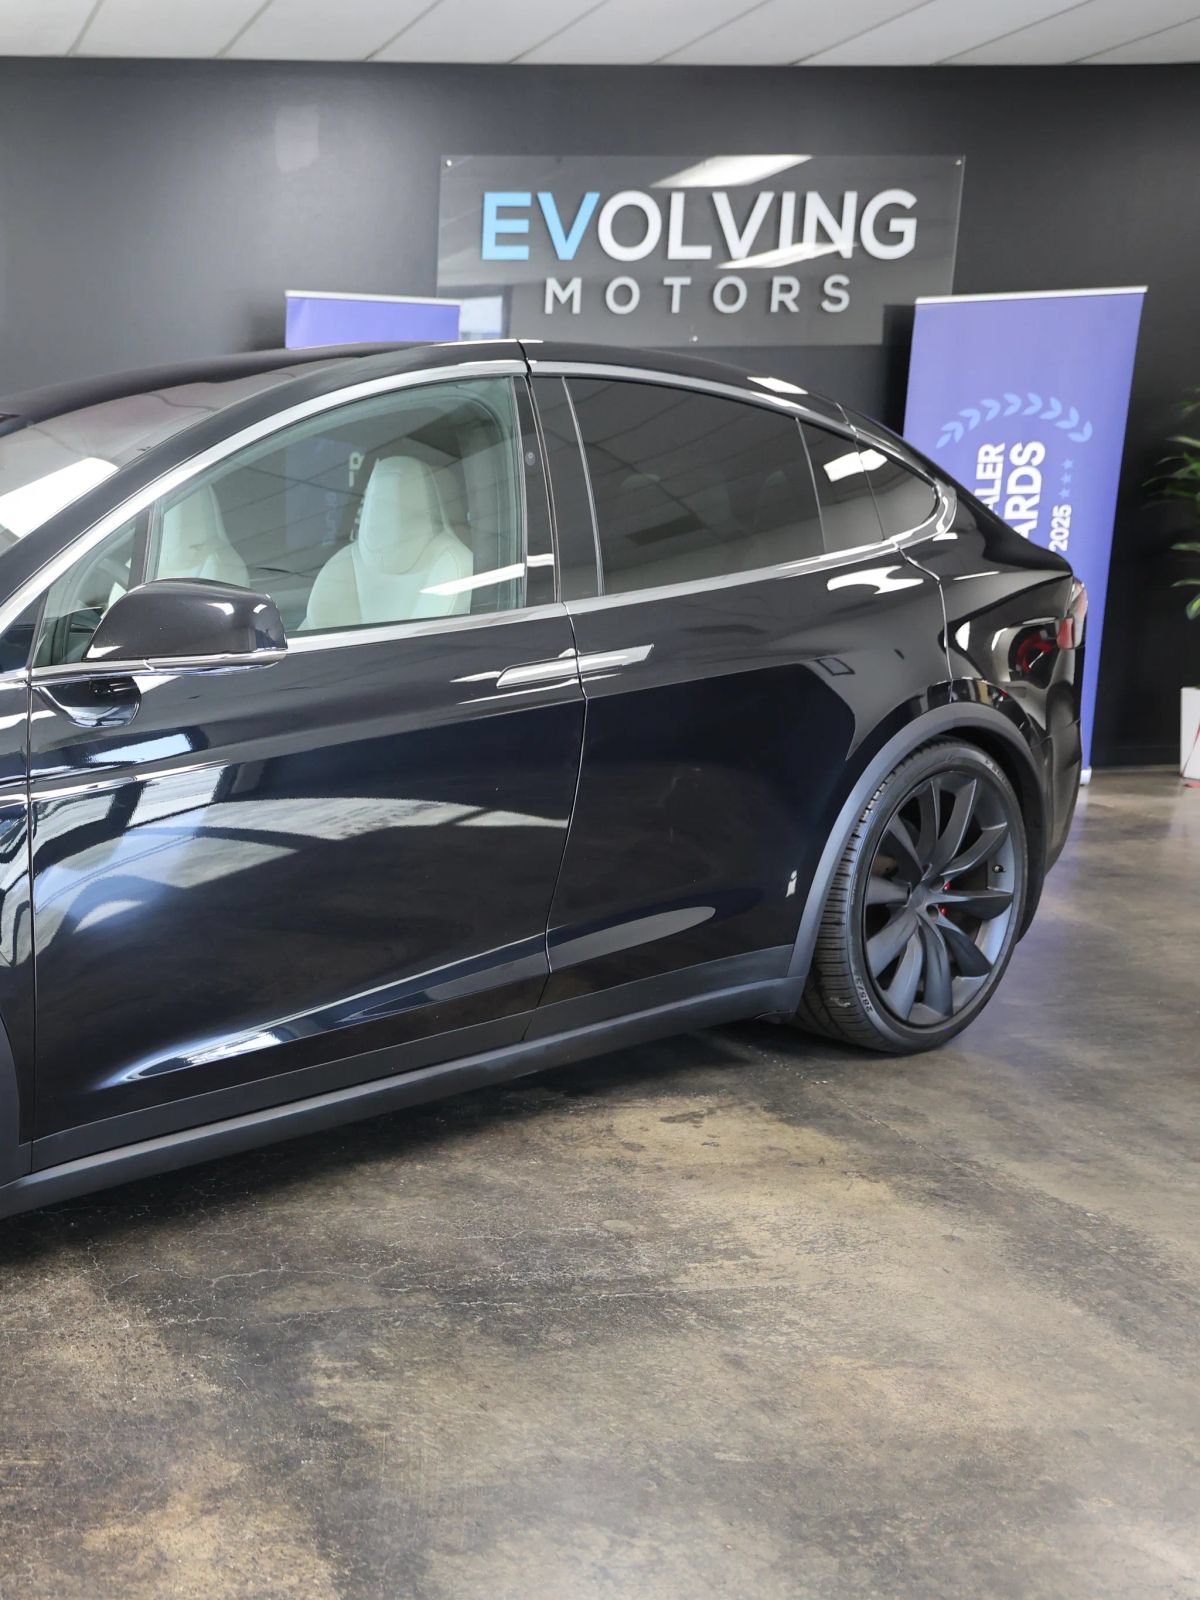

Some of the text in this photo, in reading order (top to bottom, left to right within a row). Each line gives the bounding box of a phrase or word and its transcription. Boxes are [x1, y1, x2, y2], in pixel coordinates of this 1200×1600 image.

[482, 189, 919, 263] EVOLVING
[544, 275, 851, 316] MOTORS
[1048, 503, 1073, 554] 2025
